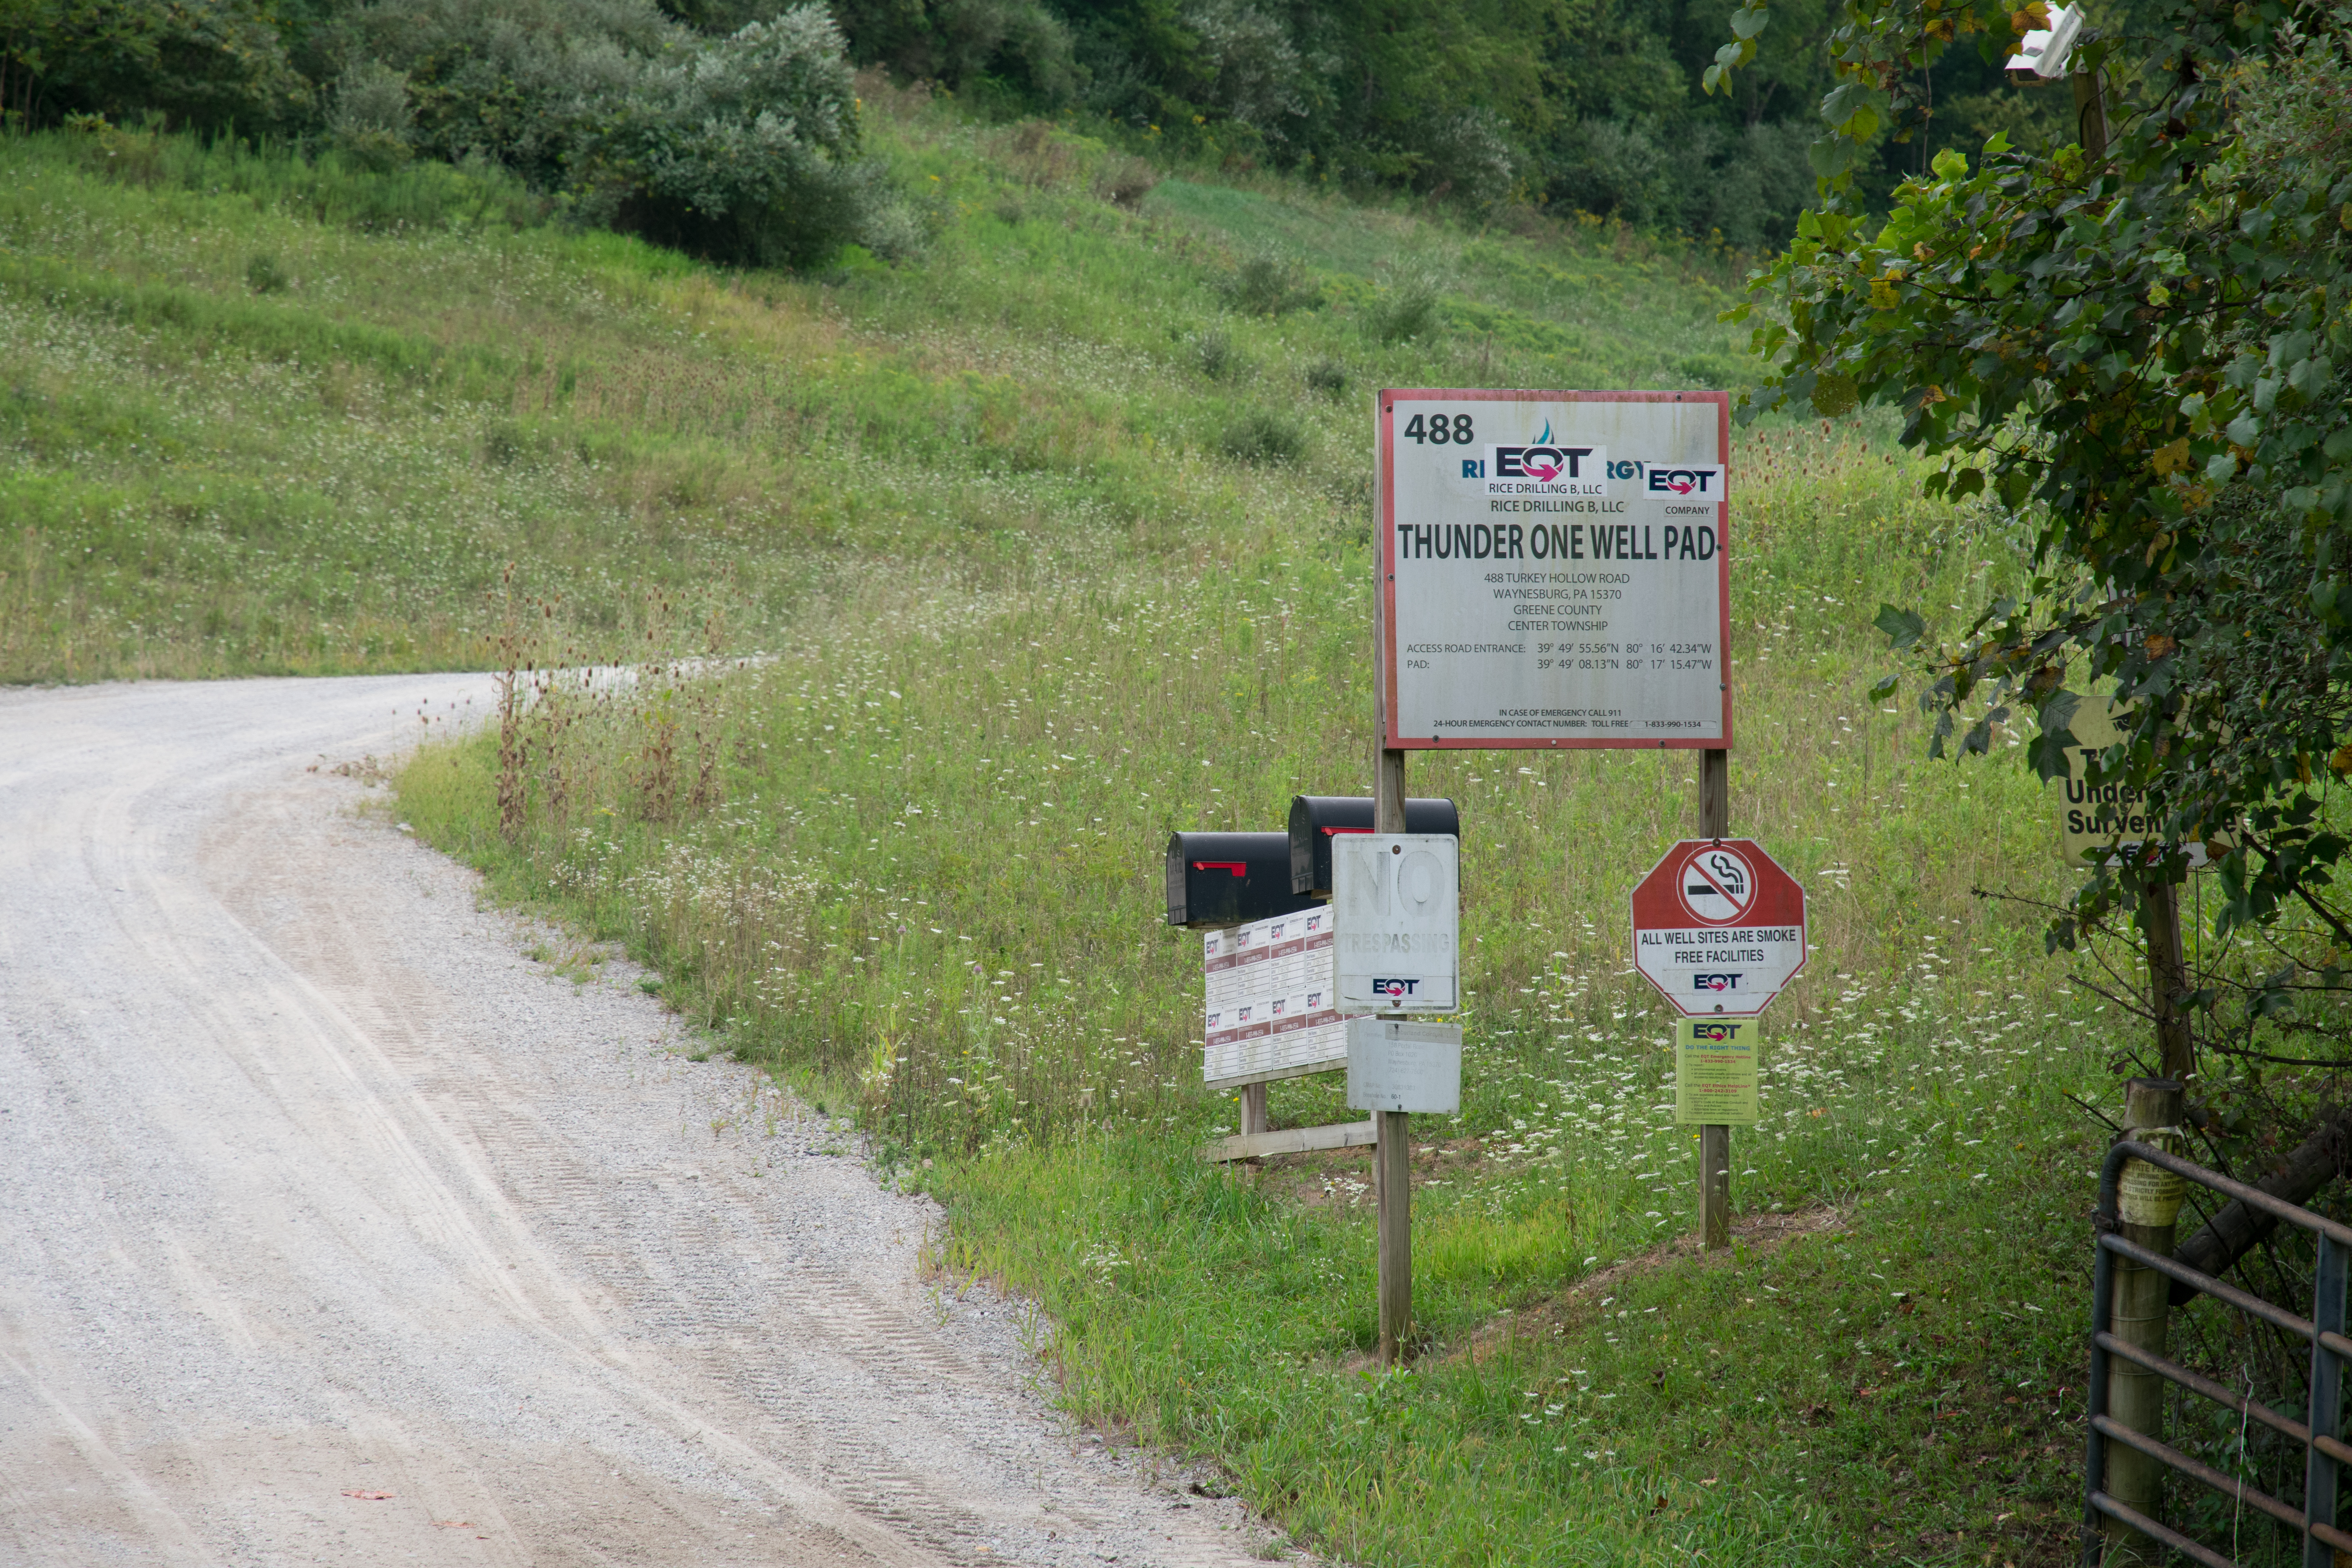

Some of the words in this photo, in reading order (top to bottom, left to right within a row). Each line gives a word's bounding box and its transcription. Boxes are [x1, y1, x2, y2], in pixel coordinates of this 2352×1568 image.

[1404, 414, 1474, 445] 488
[1496, 447, 1593, 482] EQT
[1490, 483, 1513, 493] RICE
[1516, 484, 1566, 494] DRILLING
[1570, 485, 1580, 495] B,
[1583, 485, 1602, 494] LLC
[1649, 469, 1717, 495] EQT
[1491, 501, 1519, 512] RICE
[1523, 501, 1584, 512] DRILLING
[1588, 501, 1598, 514] B,
[1602, 501, 1624, 512] LLC
[1665, 506, 1710, 514] COMPANY
[1398, 524, 1524, 559] THUNDER
[1530, 524, 1583, 559] ONE
[1590, 525, 1657, 560] WELL
[1664, 526, 1715, 561] PAD
[1484, 573, 1504, 583] 488
[1506, 573, 1546, 583] TURKEY
[1550, 573, 1597, 583] HOLLOW
[1600, 573, 1630, 583] ROAD
[1494, 589, 1571, 600] WAYNESBURG,
[1574, 589, 1588, 599] PA
[1591, 590, 1621, 599] 15370
[1514, 605, 1555, 615] GREENE
[1557, 605, 1602, 615] COUNTY
[1508, 621, 1549, 630] CENTER
[1551, 621, 1608, 631] TOWNSHIP
[1407, 644, 1442, 653] ACCESS
[1445, 644, 1472, 653] ROAD
[1475, 644, 1526, 653] ENTRANCE:
[1537, 643, 1554, 653] 39°
[1626, 643, 1643, 653] 80°
[1407, 660, 1430, 669] PAD:
[1537, 659, 1554, 669] 39°
[1626, 659, 1643, 669] 80°
[1347, 850, 1445, 917] NO
[1307, 915, 1321, 931] EQT
[1271, 923, 1285, 939] EQT
[1641, 933, 1662, 945] ALL
[1664, 932, 1695, 944] WELL
[1698, 931, 1728, 944] SITES
[1732, 931, 1753, 943] ARE
[1757, 929, 1796, 942] SMOKE
[1237, 931, 1250, 947] EQT
[1342, 933, 1449, 953] TRESPASSING
[1206, 939, 1218, 955] EQT
[1278, 945, 1297, 956] 1-833-990-1534
[1244, 953, 1262, 964] 1-833-990-1534
[1675, 951, 1703, 963] FREE
[1706, 949, 1764, 962] FACILITIES
[1373, 979, 1421, 997] EQT
[1694, 974, 1743, 991] EQT
[1272, 999, 1285, 1014] EQT
[1307, 993, 1321, 1008] EQT
[1207, 1013, 1221, 1028] EQT
[1239, 1006, 1252, 1022] EQT
[1315, 1015, 1335, 1025] 1-833-990-1534
[1246, 1029, 1263, 1039] 1-833-990-1534
[1280, 1022, 1299, 1032] 1-833-990-1534
[1693, 1024, 1743, 1042] EQT
[1213, 1036, 1231, 1045] 1-833-990-1534
[2129, 1186, 2154, 1194] STRICTLY
